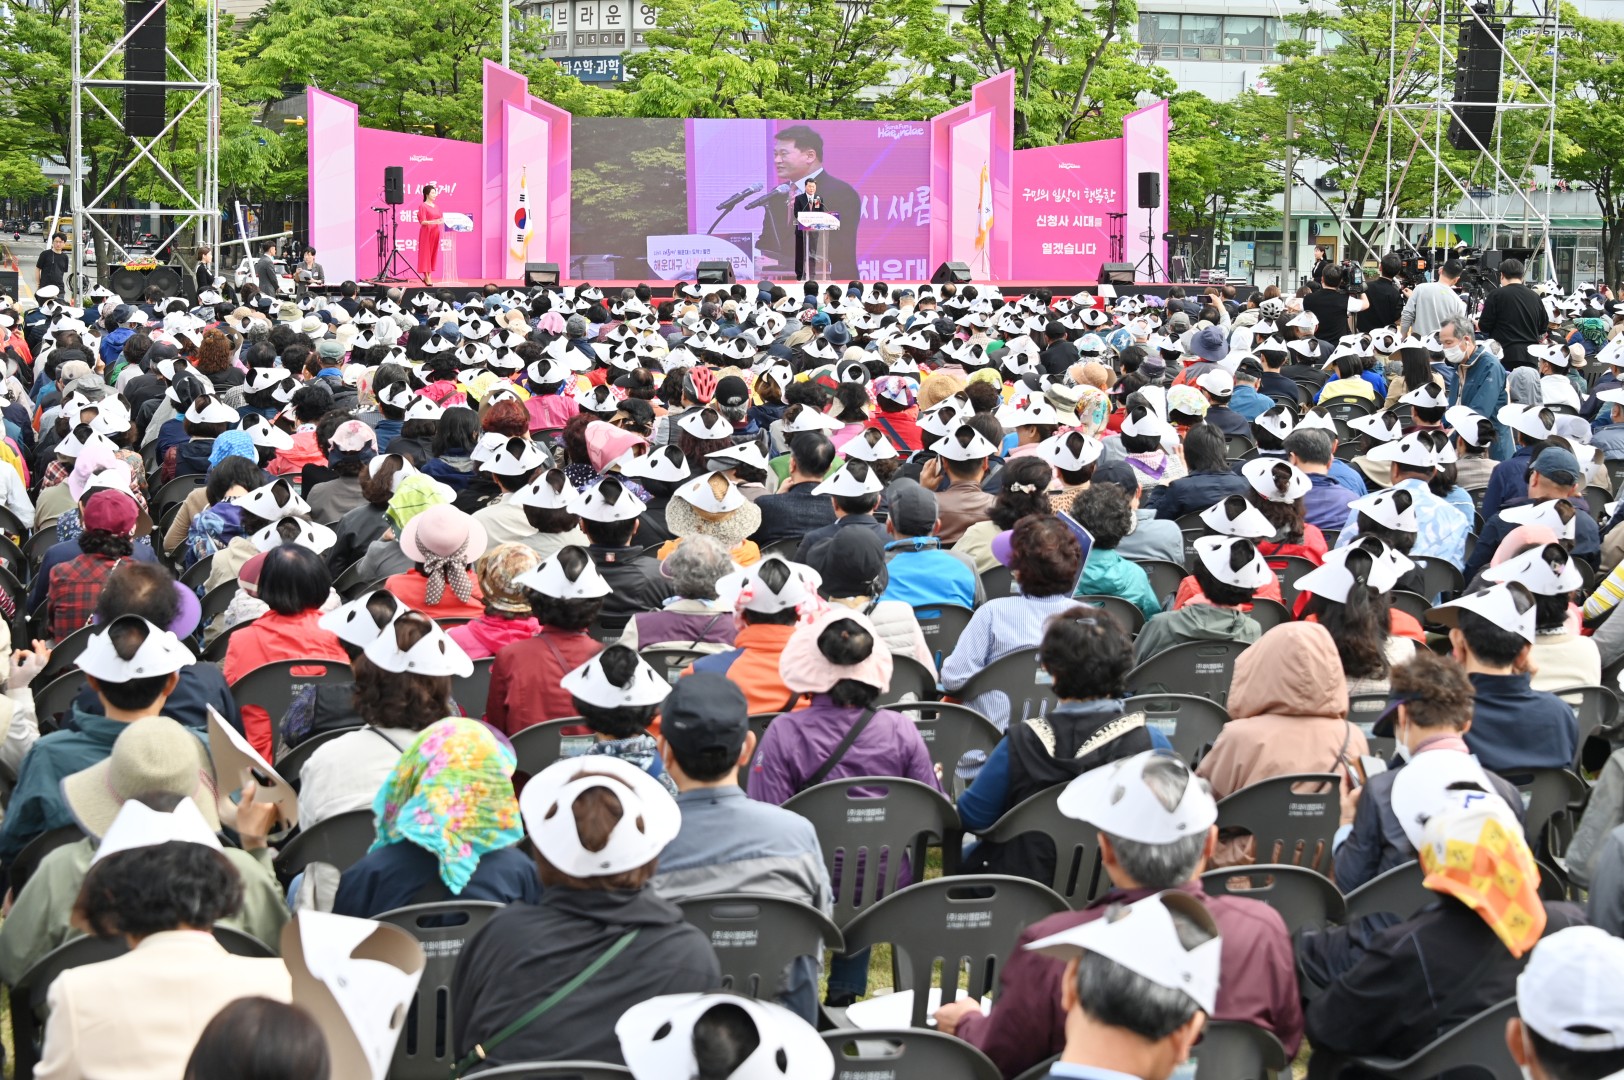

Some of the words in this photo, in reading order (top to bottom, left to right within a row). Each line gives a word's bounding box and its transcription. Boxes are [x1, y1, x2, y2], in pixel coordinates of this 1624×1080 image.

[877, 126, 925, 139] Haeundae
[1022, 187, 1049, 202] 구민의
[1052, 187, 1080, 203] 일상이
[1084, 187, 1116, 204] 행복한
[887, 185, 931, 227] 새롭
[1036, 215, 1069, 227] 신청사
[1042, 243, 1096, 255] 열겠습니다
